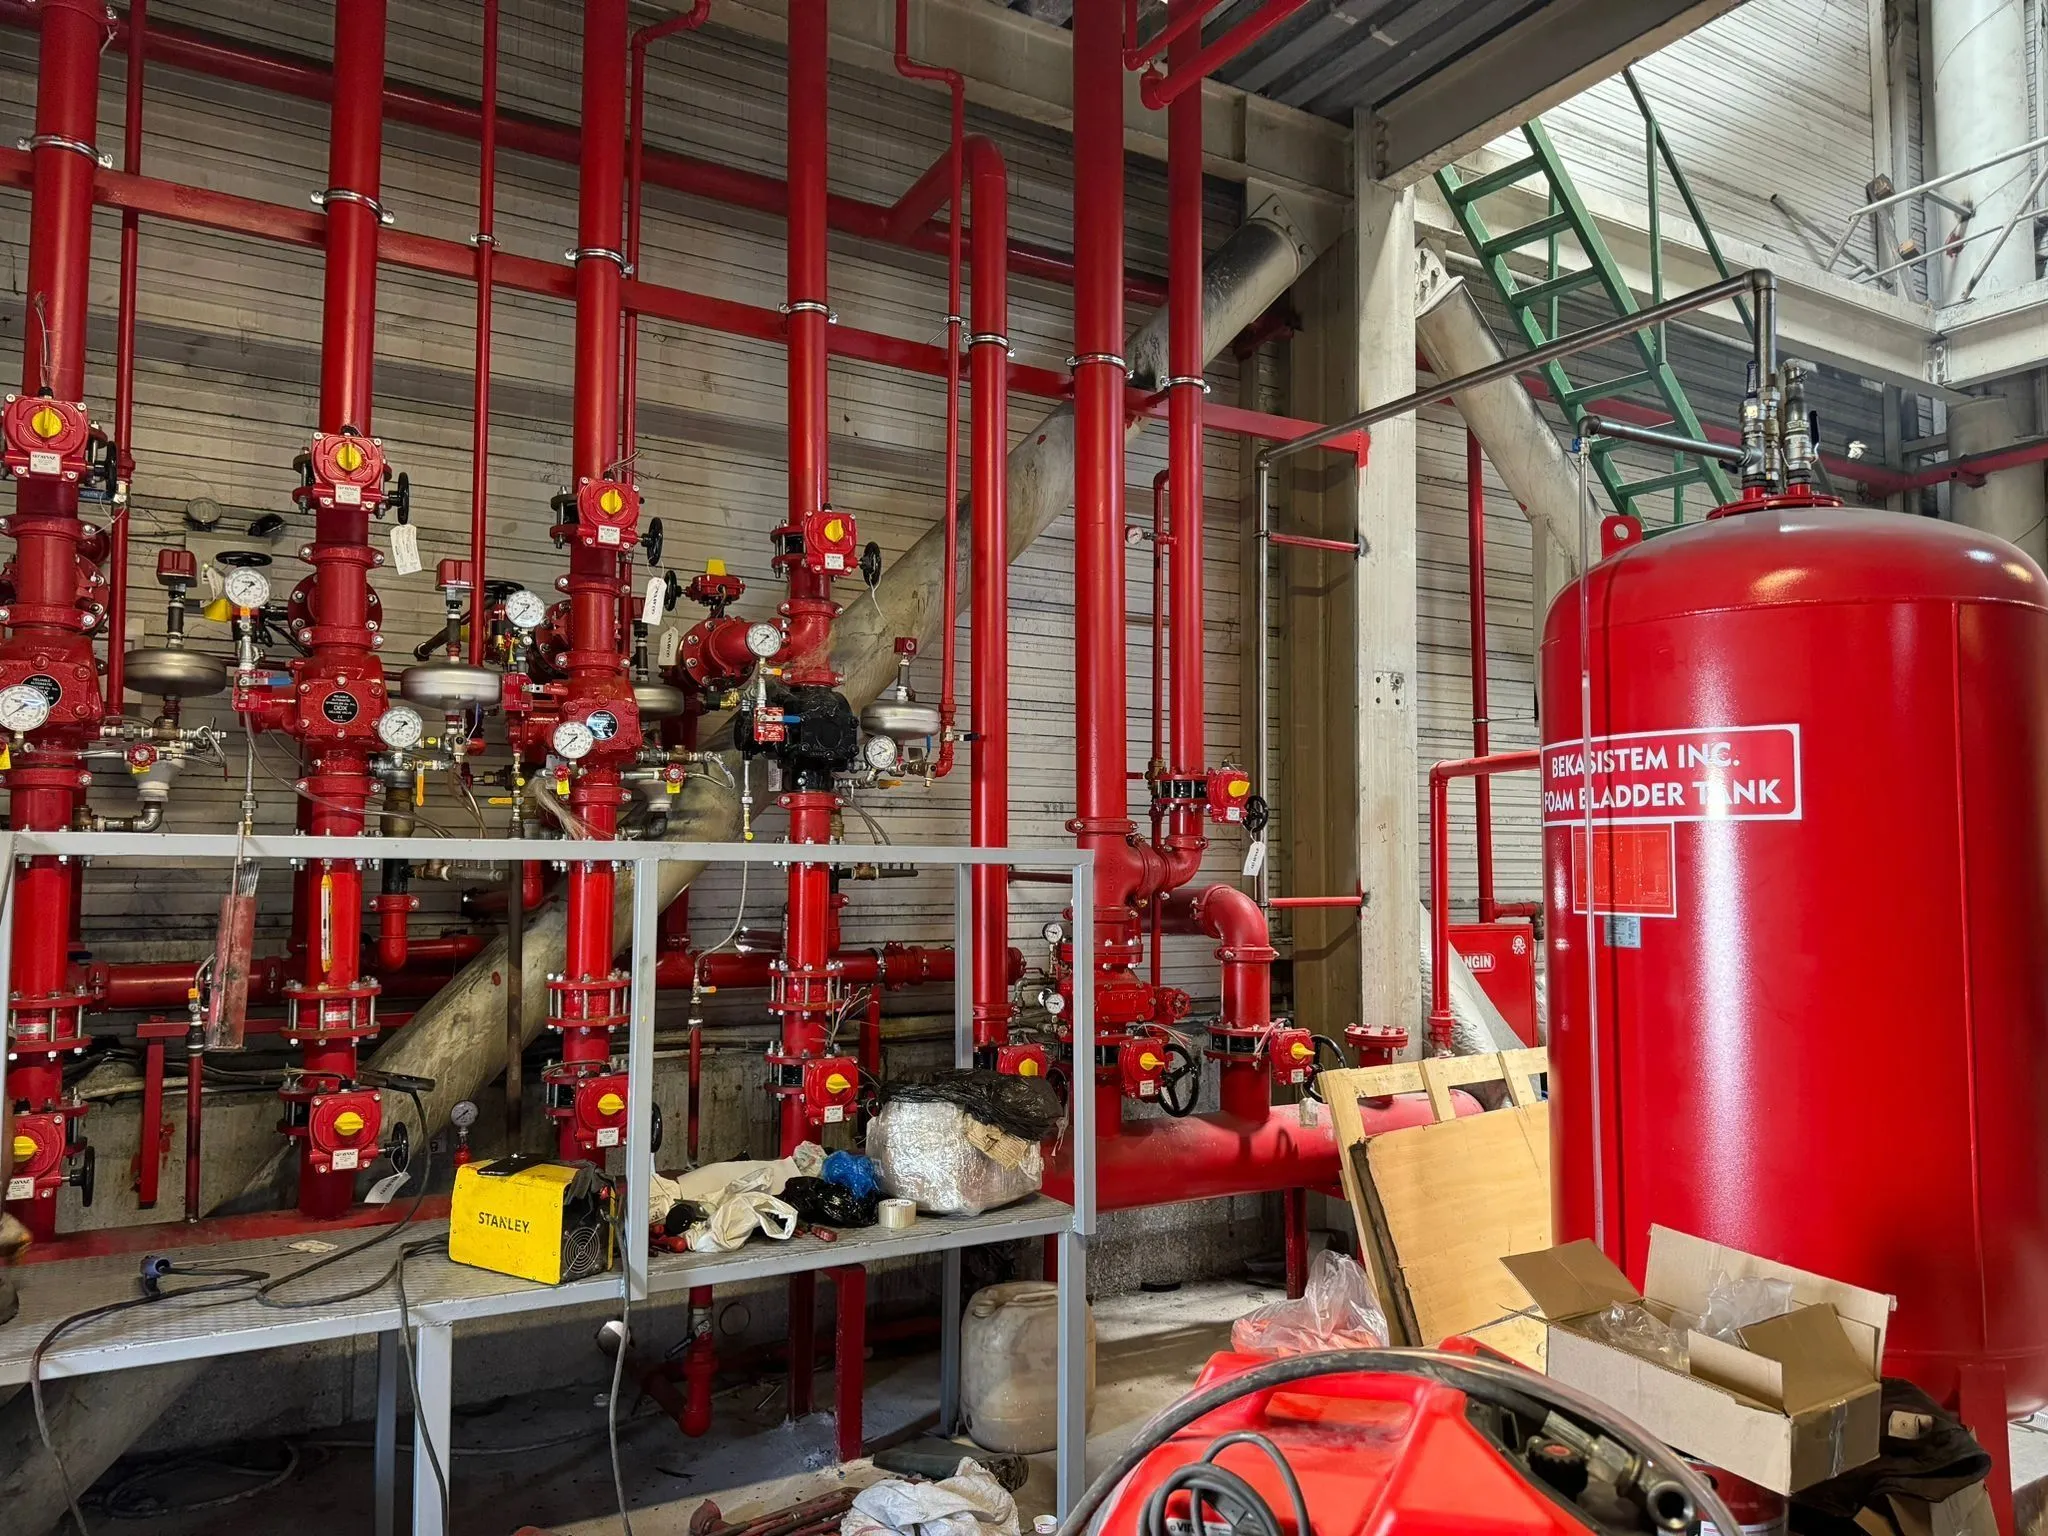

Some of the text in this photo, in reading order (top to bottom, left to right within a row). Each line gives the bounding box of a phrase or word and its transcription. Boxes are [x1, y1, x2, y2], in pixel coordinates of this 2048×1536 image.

[1552, 742, 1741, 778] BEKASISTEM INC.
[1544, 788, 1574, 812] FOAM
[1579, 783, 1685, 810] BLADDER
[1463, 955, 1492, 968] NGIN
